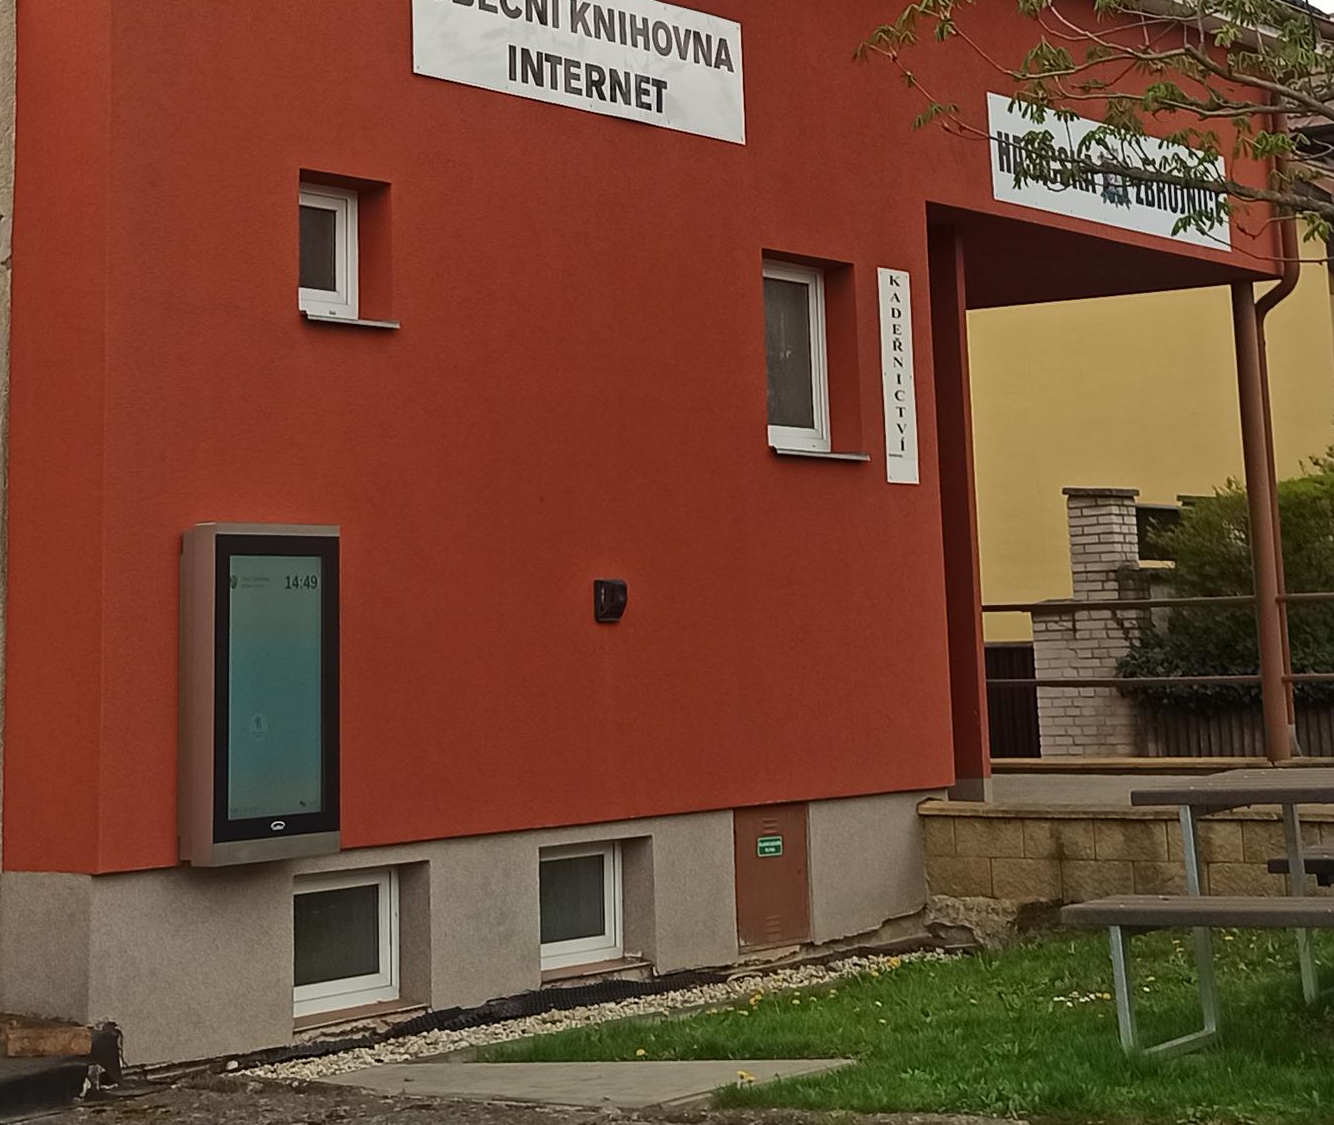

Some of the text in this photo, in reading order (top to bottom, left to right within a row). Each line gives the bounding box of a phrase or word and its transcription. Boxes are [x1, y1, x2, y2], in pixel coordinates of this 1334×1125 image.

[508, 44, 668, 114] INTERNET
[889, 275, 907, 452] KADEŘNICTVÍ
[284, 574, 318, 590] 14:49
